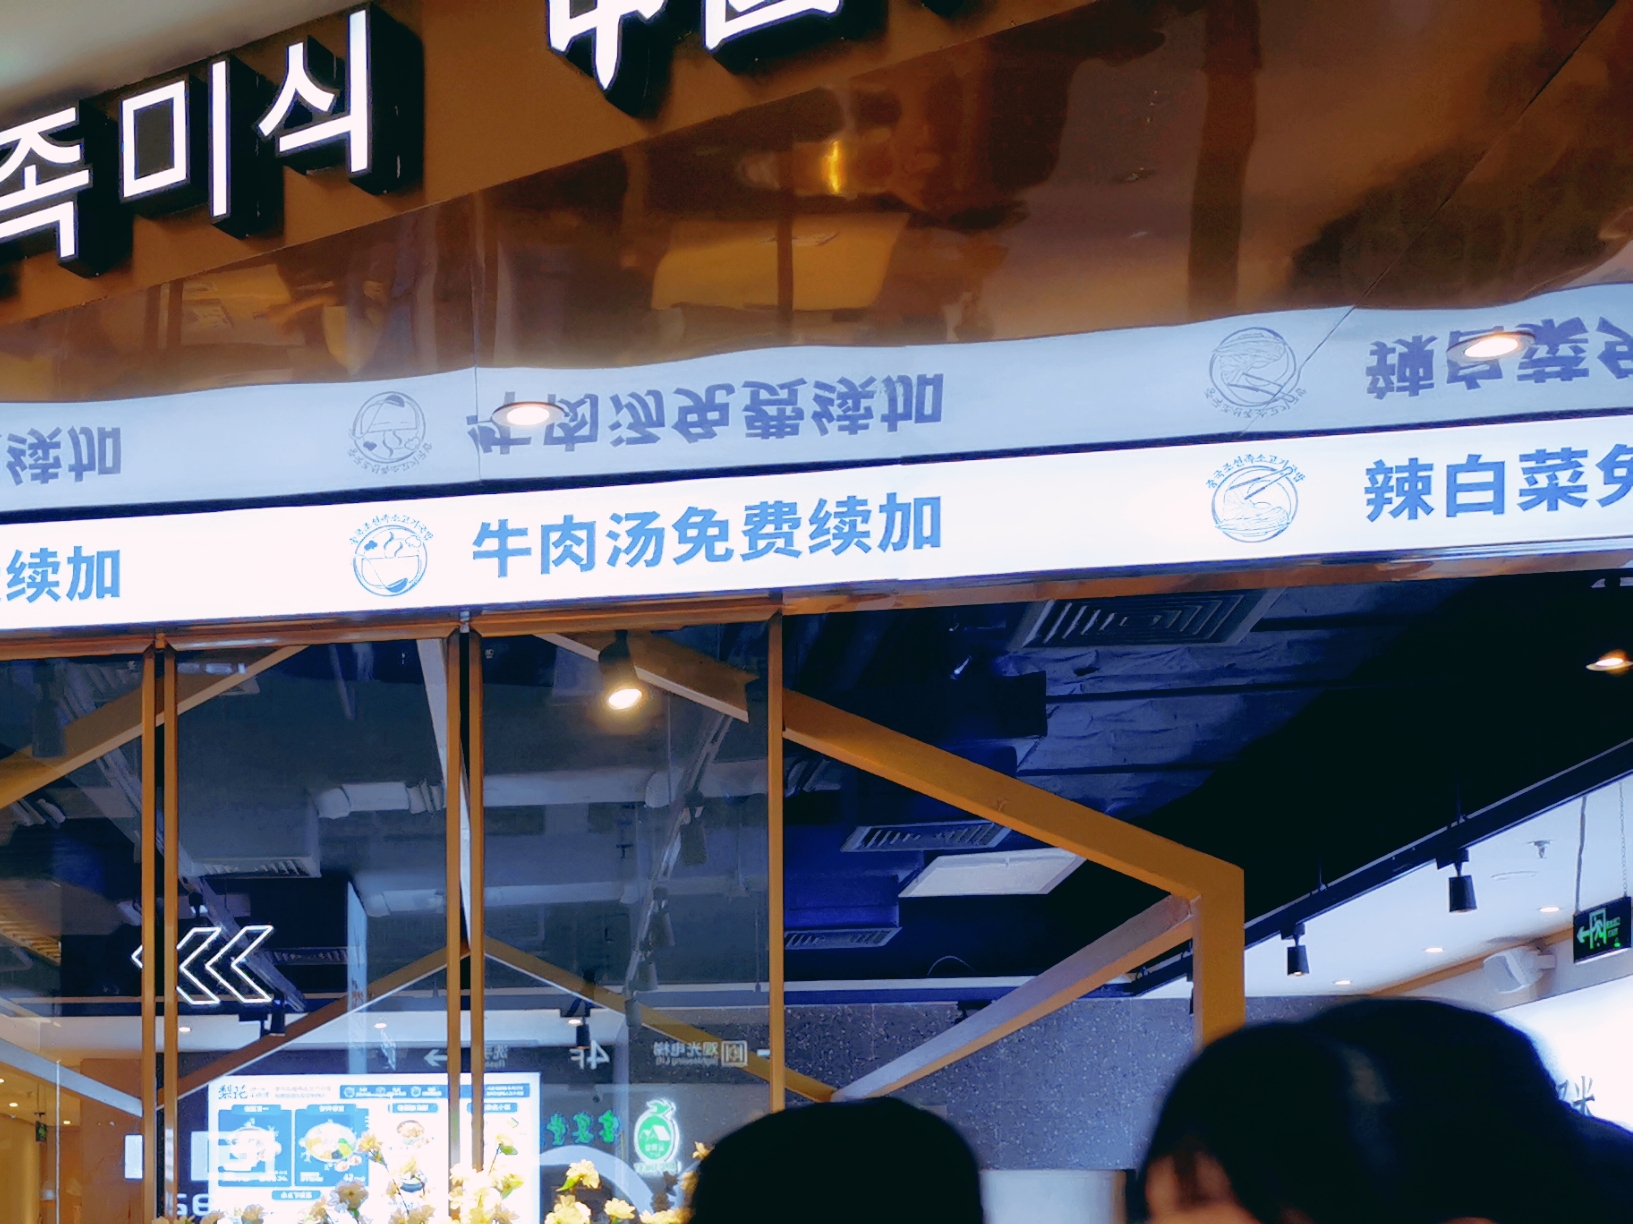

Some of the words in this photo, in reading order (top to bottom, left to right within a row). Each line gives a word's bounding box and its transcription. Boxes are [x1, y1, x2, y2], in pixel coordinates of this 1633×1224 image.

[472, 492, 942, 578] 牛肉汤免费续加
